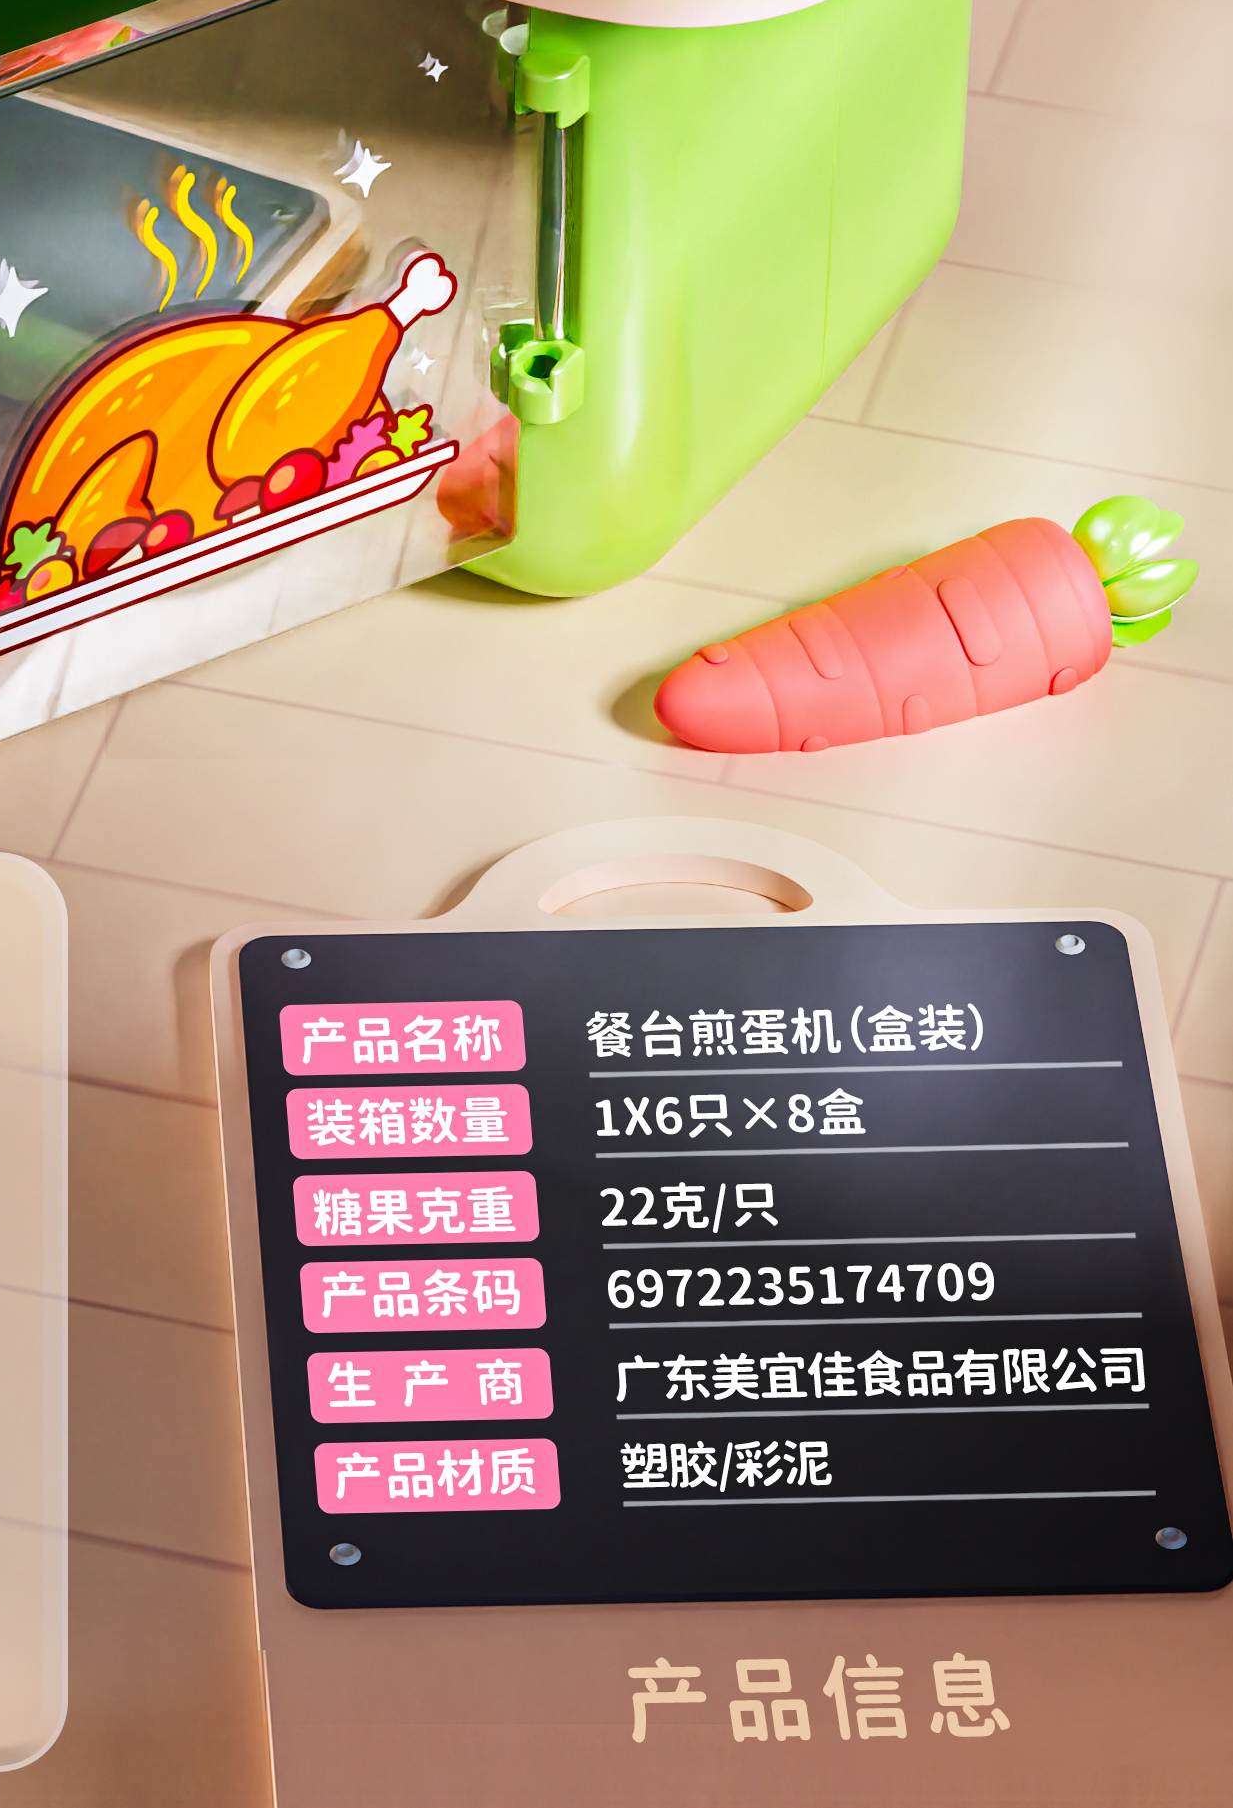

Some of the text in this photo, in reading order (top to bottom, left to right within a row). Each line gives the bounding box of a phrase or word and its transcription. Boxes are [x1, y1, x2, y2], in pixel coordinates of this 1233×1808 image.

[301, 1016, 502, 1064] 产品名称
[307, 1098, 509, 1147] 装箱数量
[314, 1188, 515, 1236] 糖果克重
[600, 1182, 779, 1235] 22克/只
[321, 1271, 522, 1318] 产品条码
[606, 1262, 996, 1310] 6972235174709
[616, 1347, 1147, 1403] 广东美宜佳食品有限公司
[336, 1450, 536, 1499] 产品材质
[620, 1440, 833, 1492] 塑胶/彩泥
